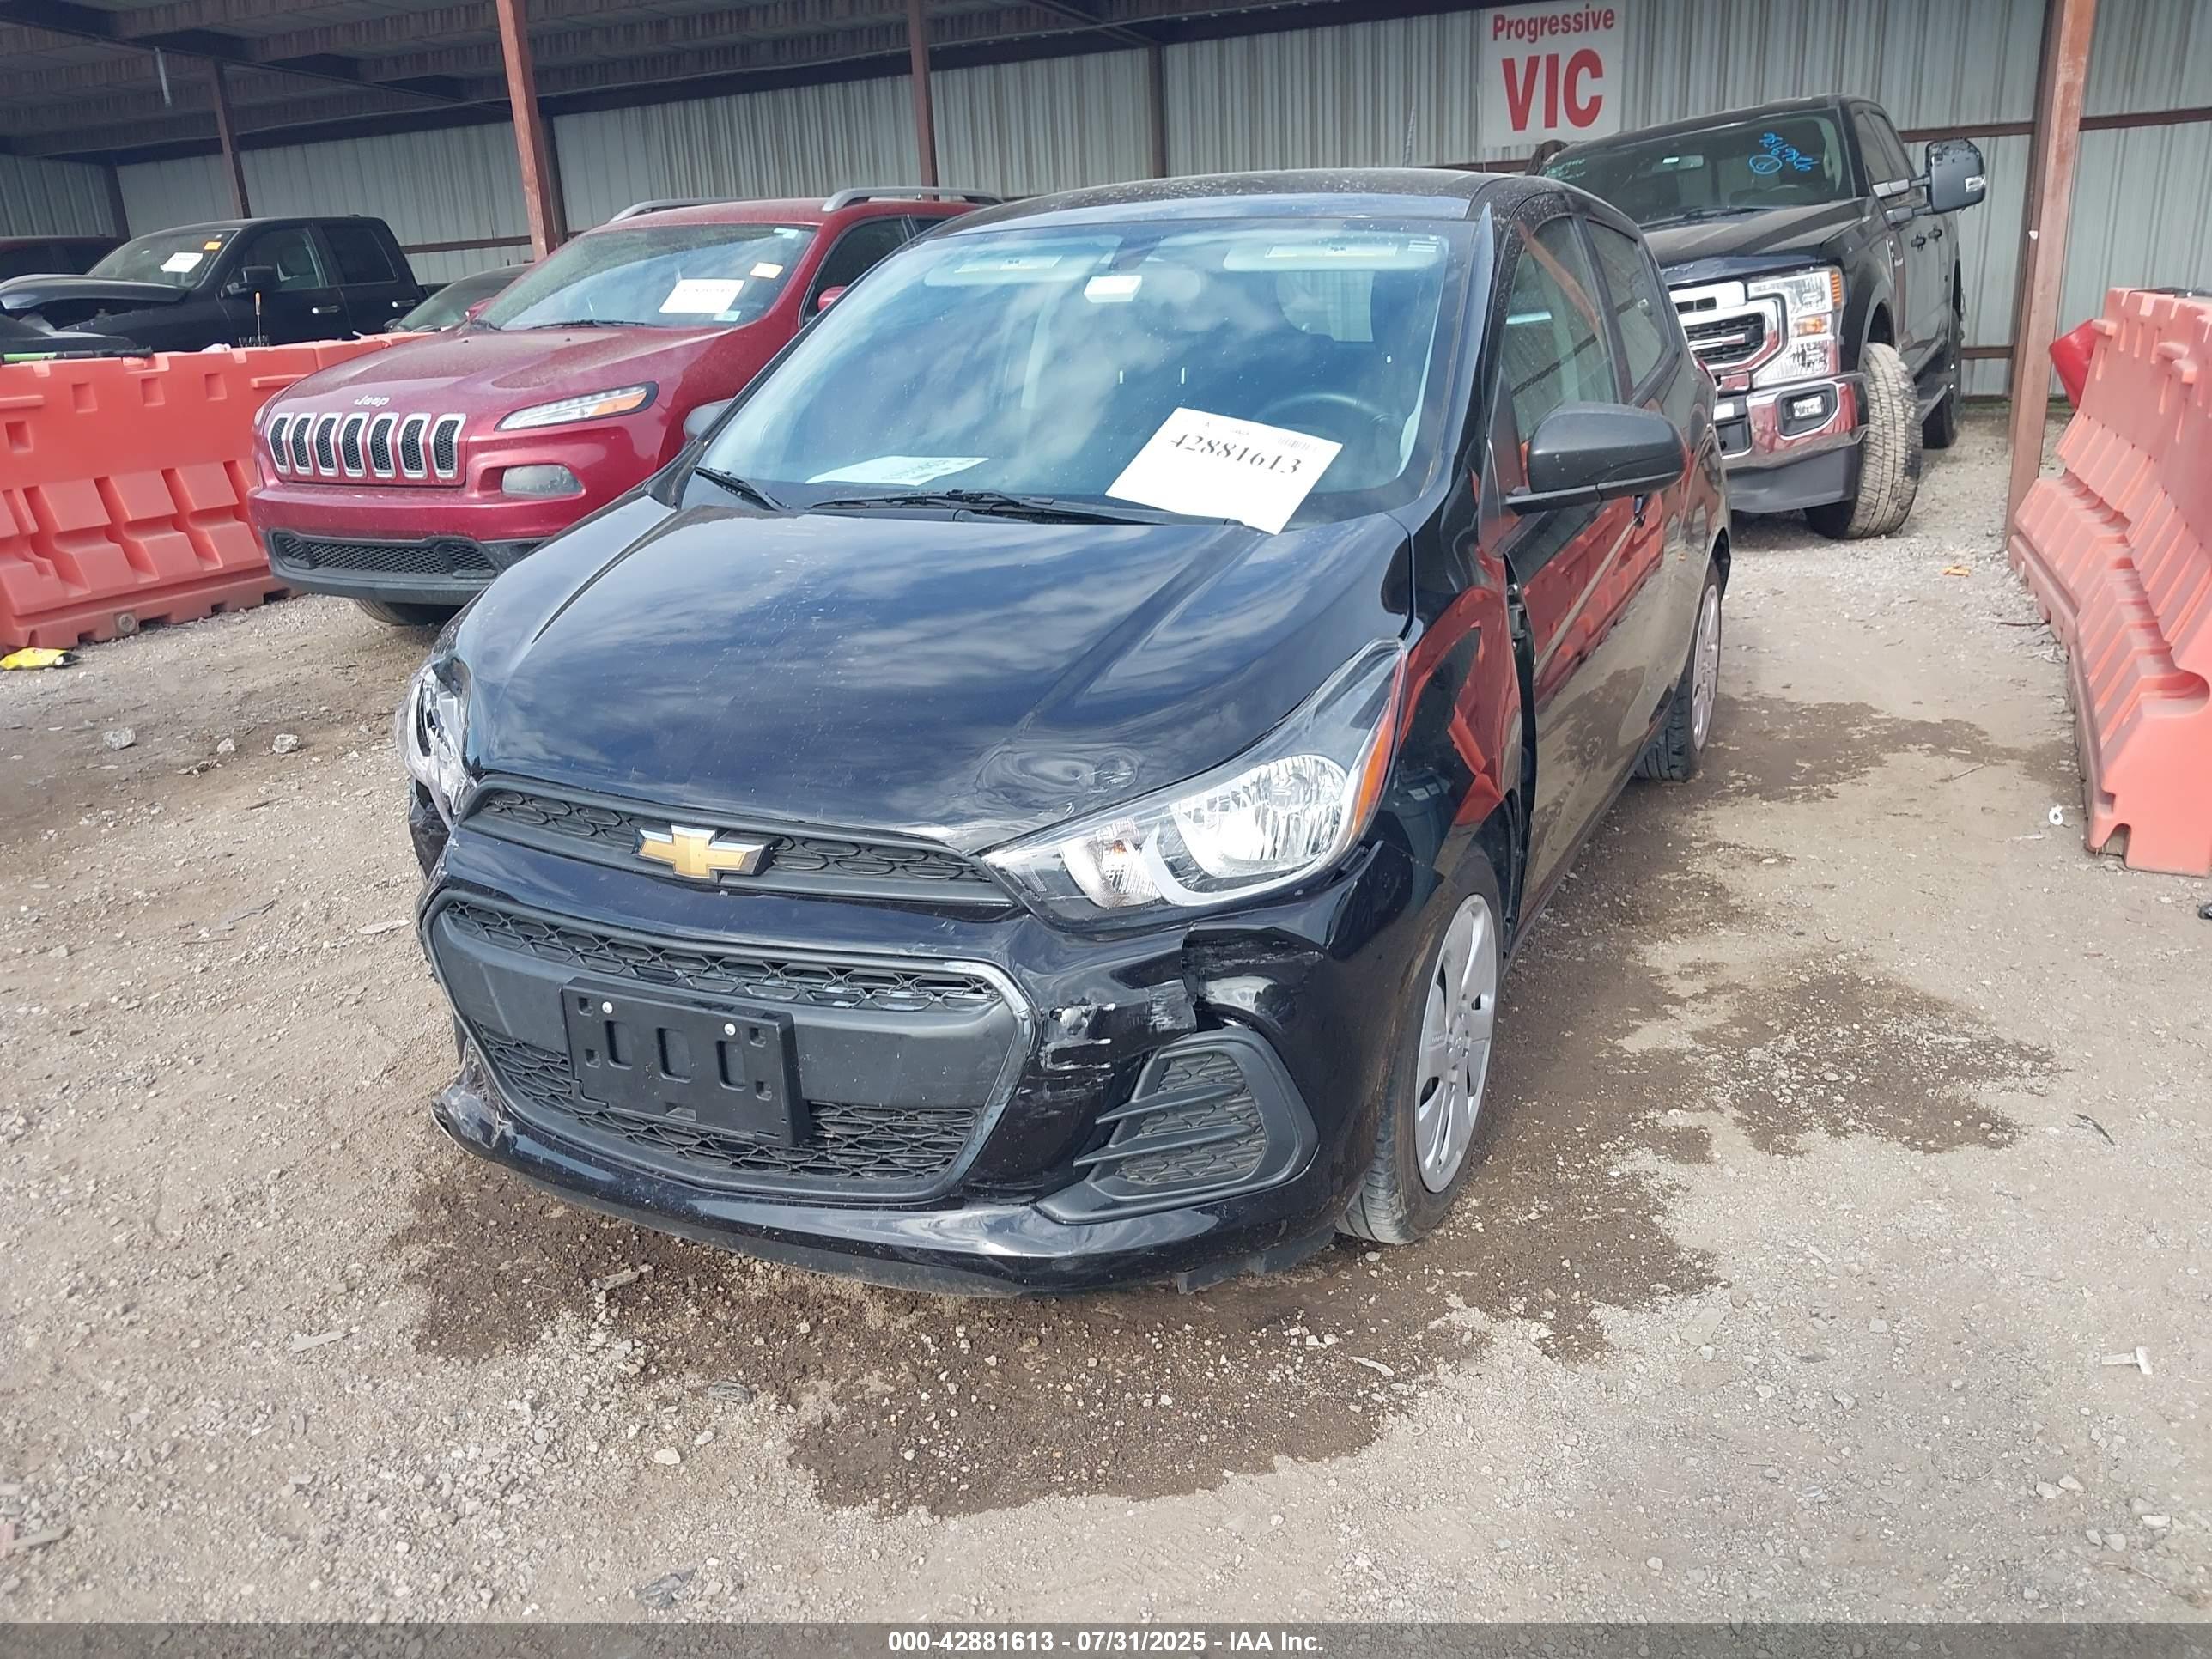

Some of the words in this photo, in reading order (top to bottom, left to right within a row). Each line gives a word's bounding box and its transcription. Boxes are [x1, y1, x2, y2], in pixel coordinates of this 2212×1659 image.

[1492, 4, 1615, 44] Progressive
[1502, 48, 1603, 131] VIC
[354, 395, 390, 407] Jeep
[1170, 433, 1302, 474] 42881613
